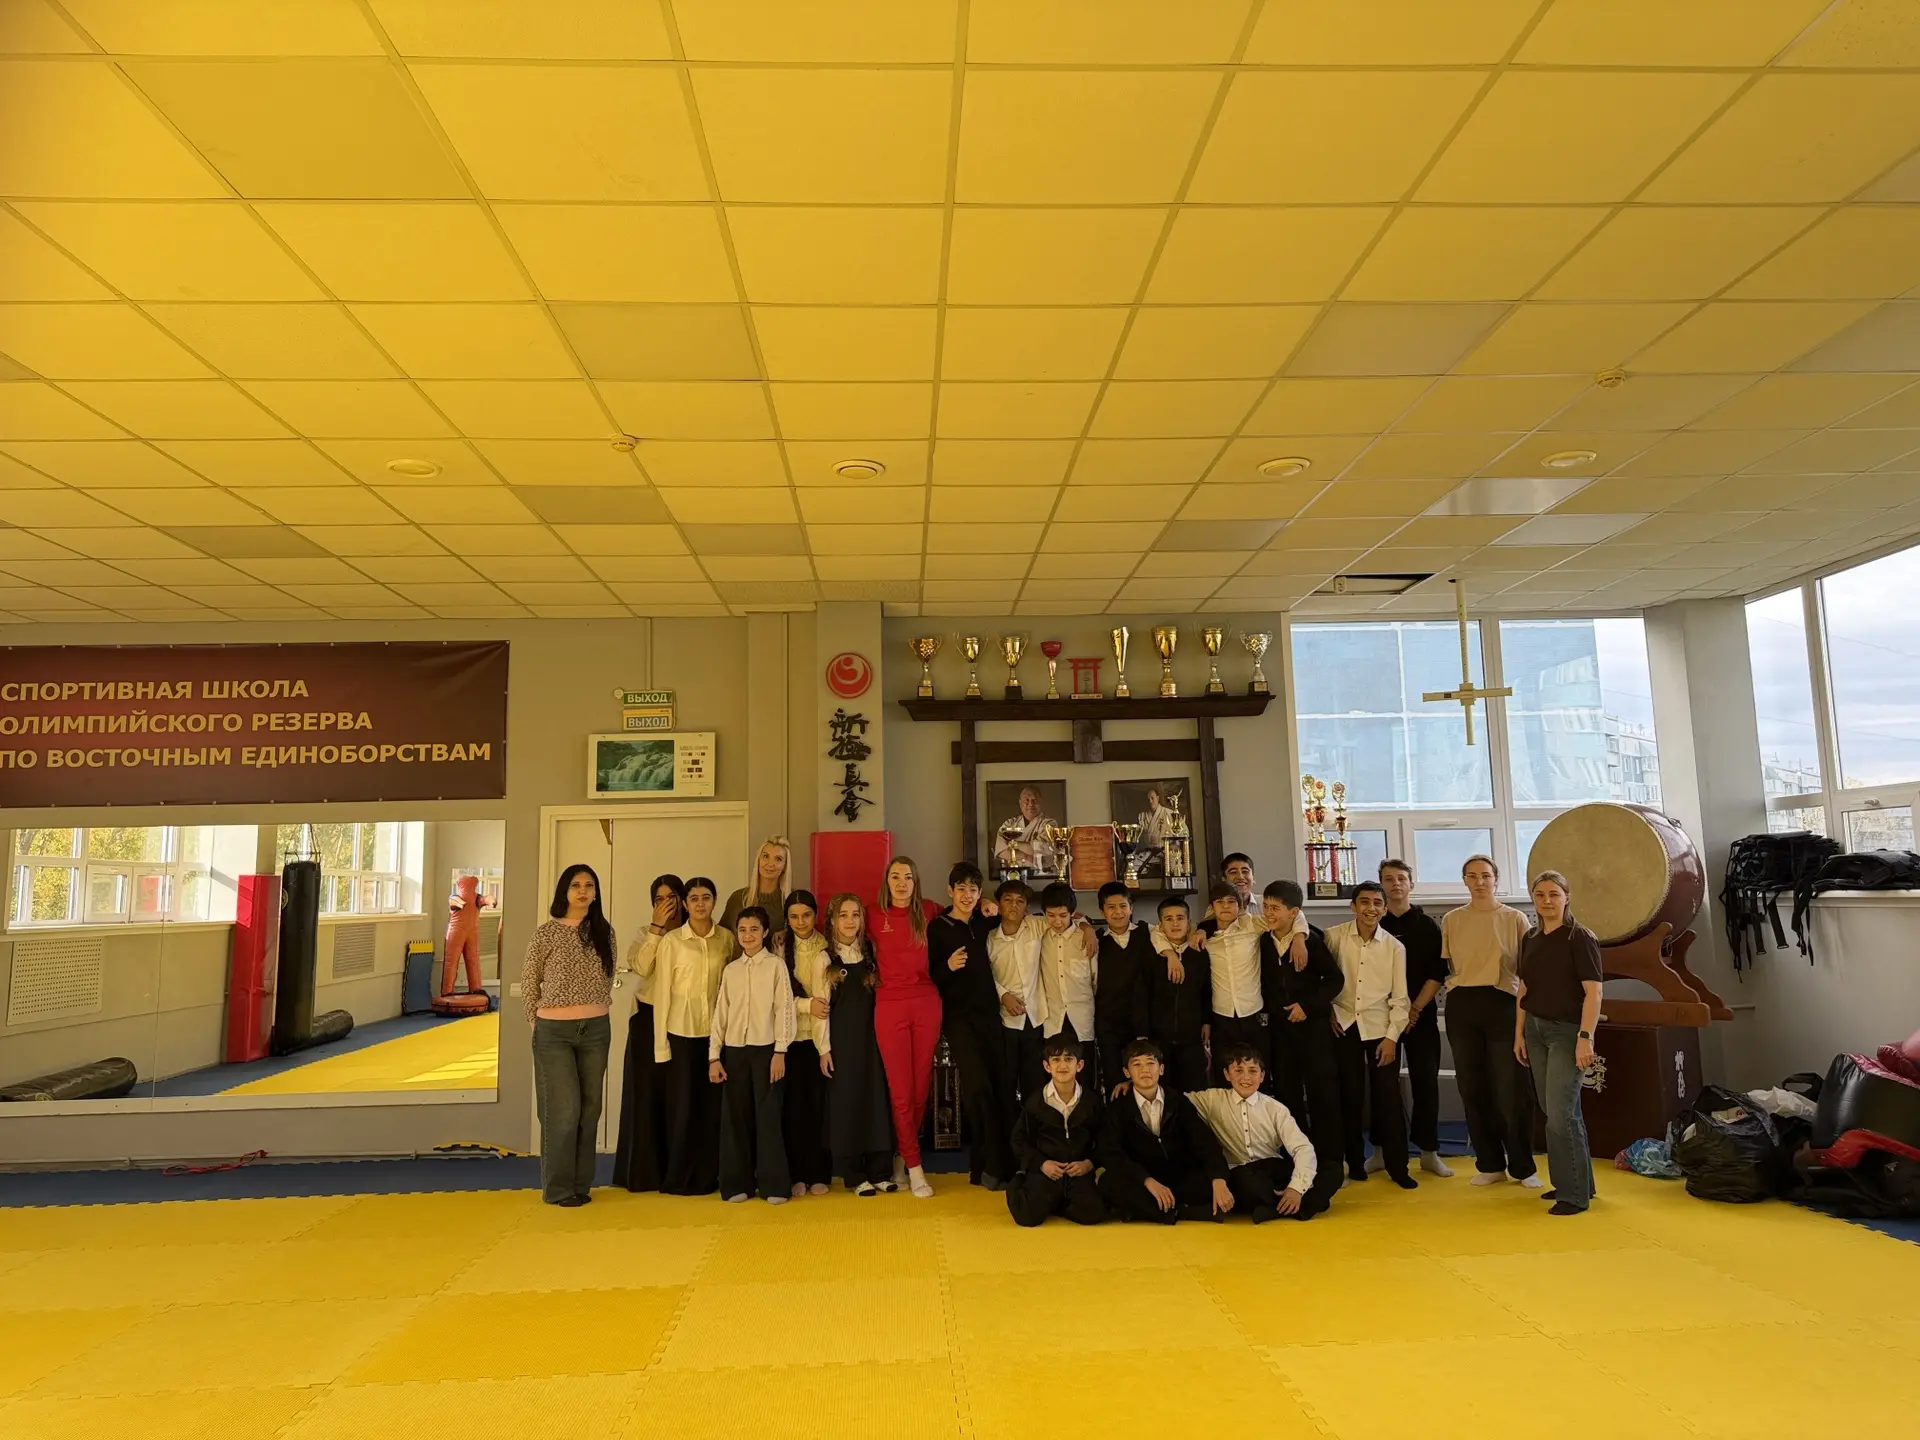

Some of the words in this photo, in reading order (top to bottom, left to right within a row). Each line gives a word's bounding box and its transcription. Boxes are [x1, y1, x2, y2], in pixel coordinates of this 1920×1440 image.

[1, 682, 192, 702] СПОРТИВНАЯ
[202, 680, 309, 699] ШКОЛА
[627, 693, 668, 703] ВЫХОД
[0, 710, 243, 735] ОЛИМПИЙСКОГО
[252, 711, 373, 732] РЕЗЕРВА
[628, 717, 668, 728] ВЫХОД
[0, 749, 38, 769] ПО
[47, 747, 231, 768] ВОСТОЧНЫМ
[241, 743, 491, 768] ЕДИНОБОРСТВАМ
